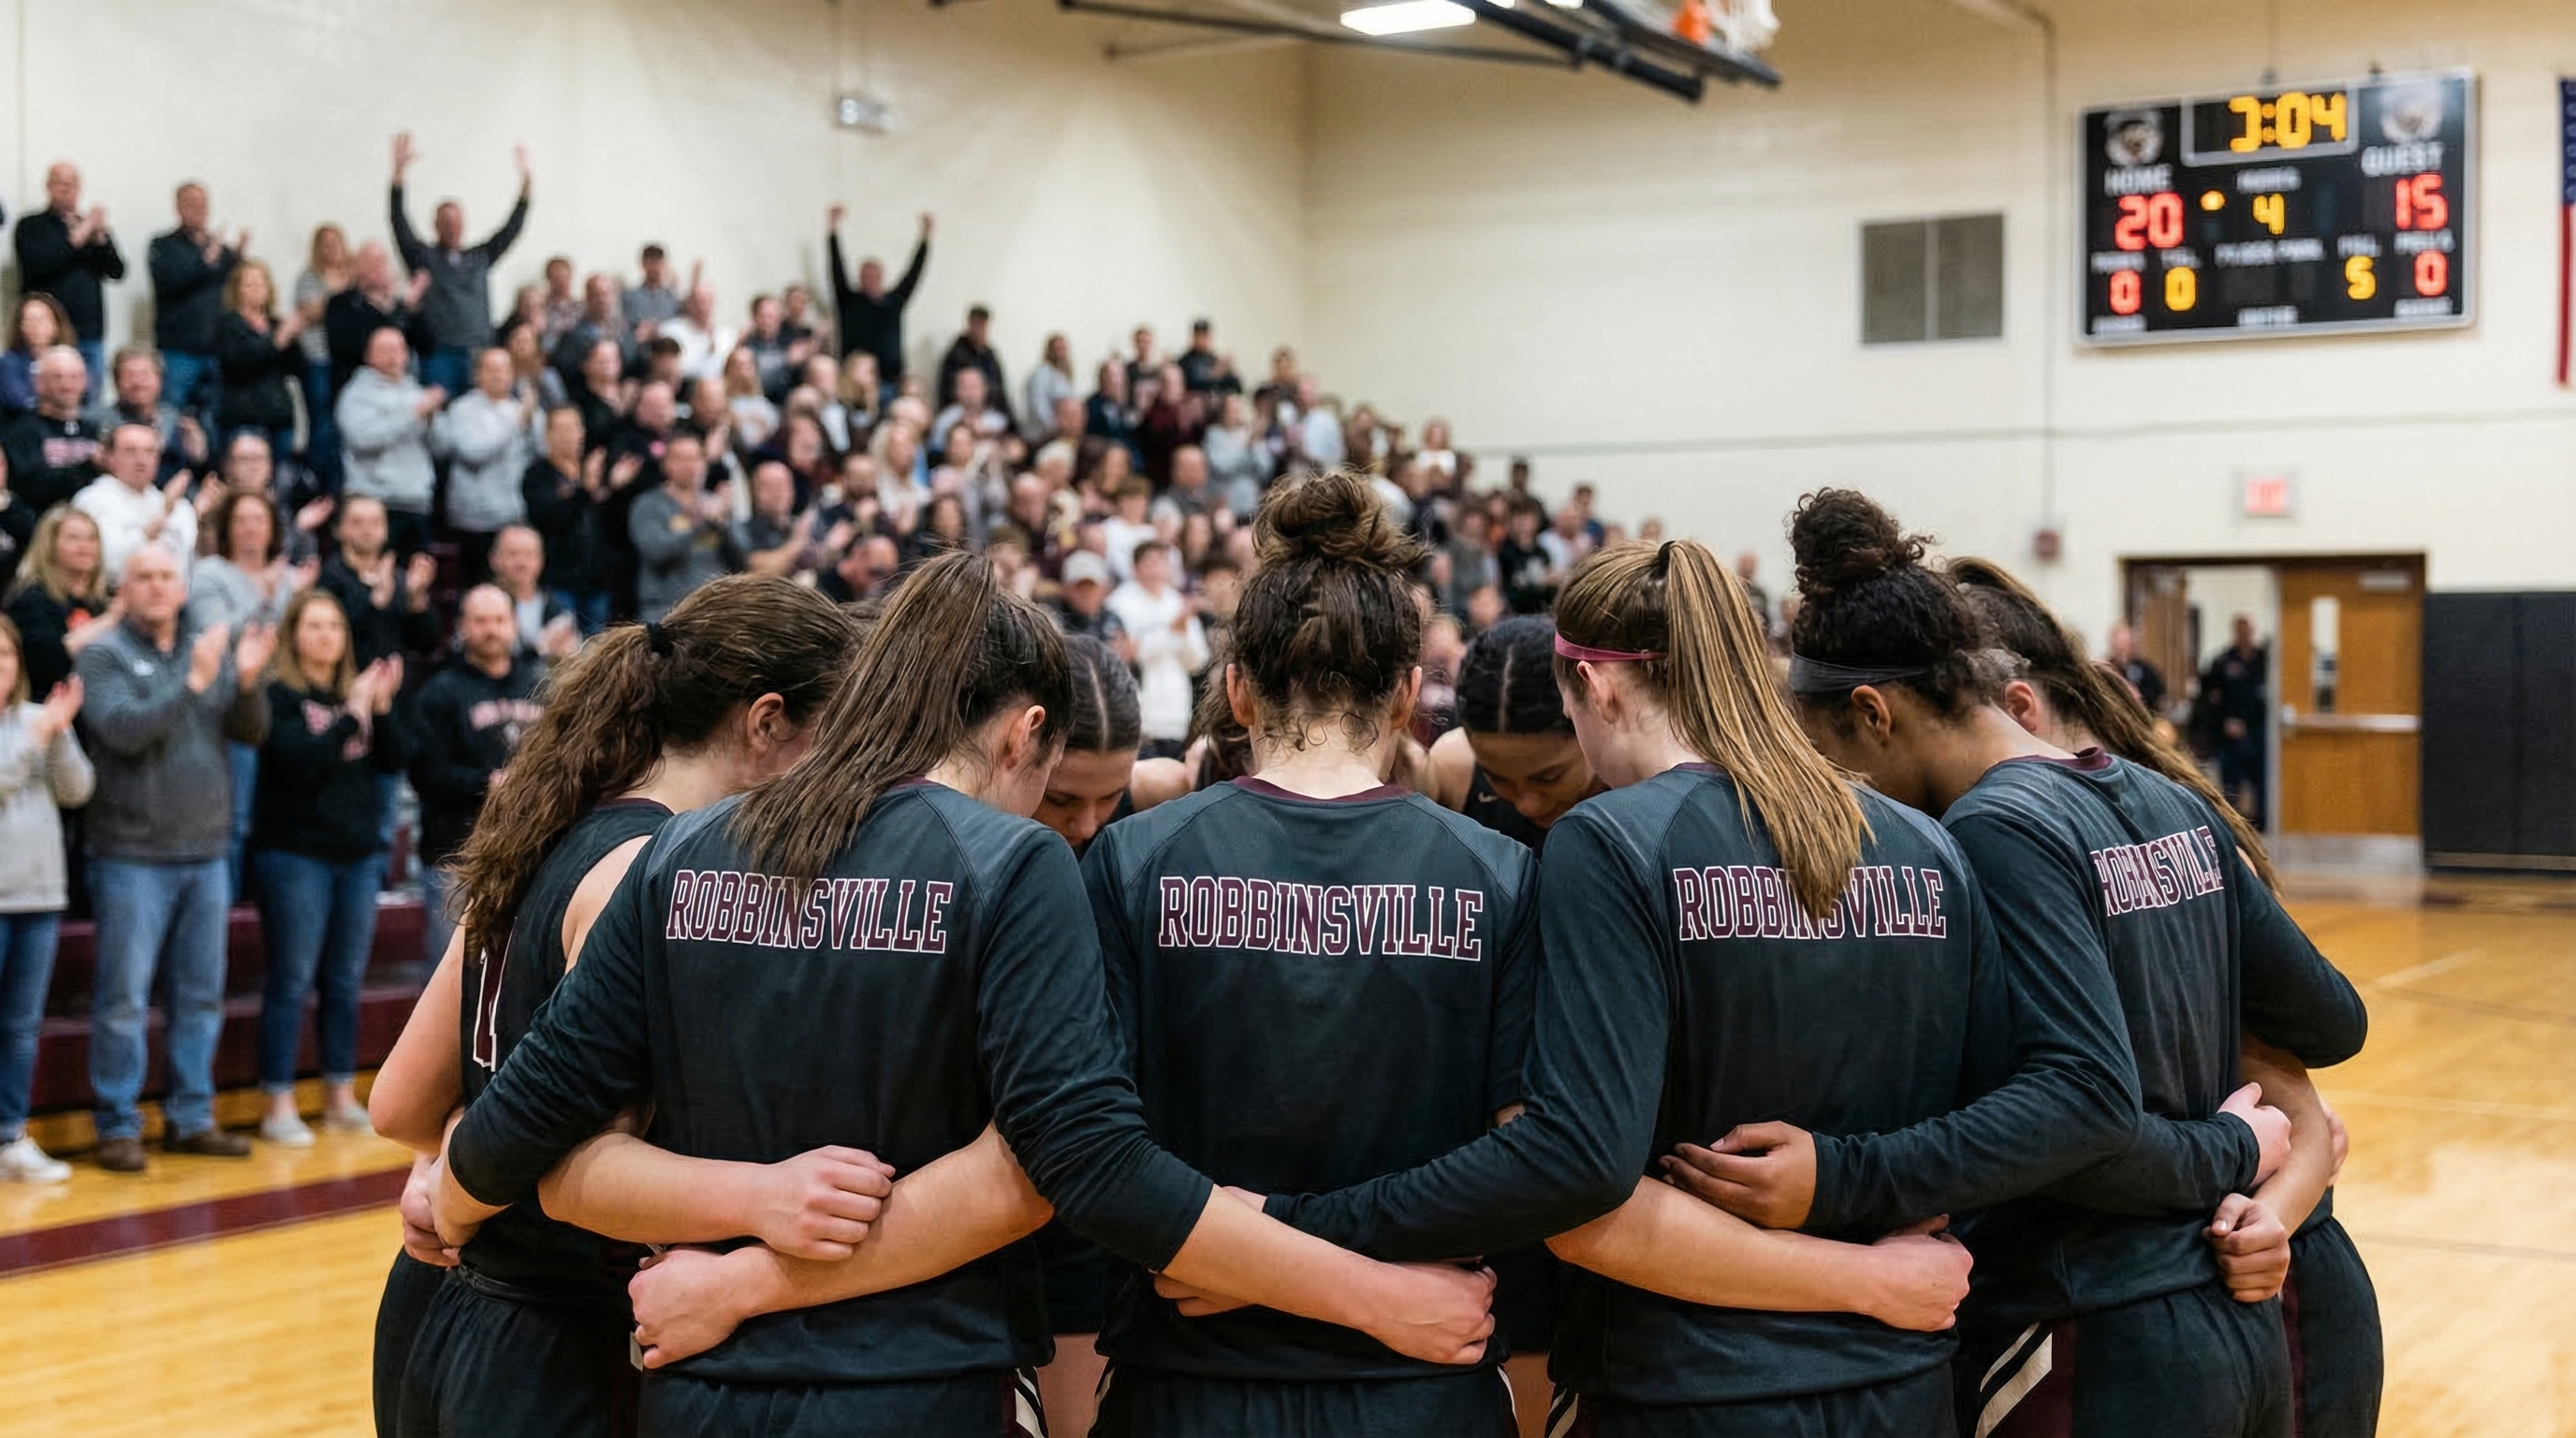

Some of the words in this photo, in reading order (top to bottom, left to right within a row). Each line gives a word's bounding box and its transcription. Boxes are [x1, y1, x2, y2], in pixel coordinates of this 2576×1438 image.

[2115, 192, 2184, 251] 20
[2252, 192, 2286, 235] 4
[2395, 172, 2449, 230] 15
[2109, 269, 2142, 315] 0
[2165, 265, 2197, 312] 0
[2414, 249, 2449, 298] 0
[666, 869, 954, 954] ROBBINSVILLE
[1158, 875, 1484, 961] ROBBINSVILLE
